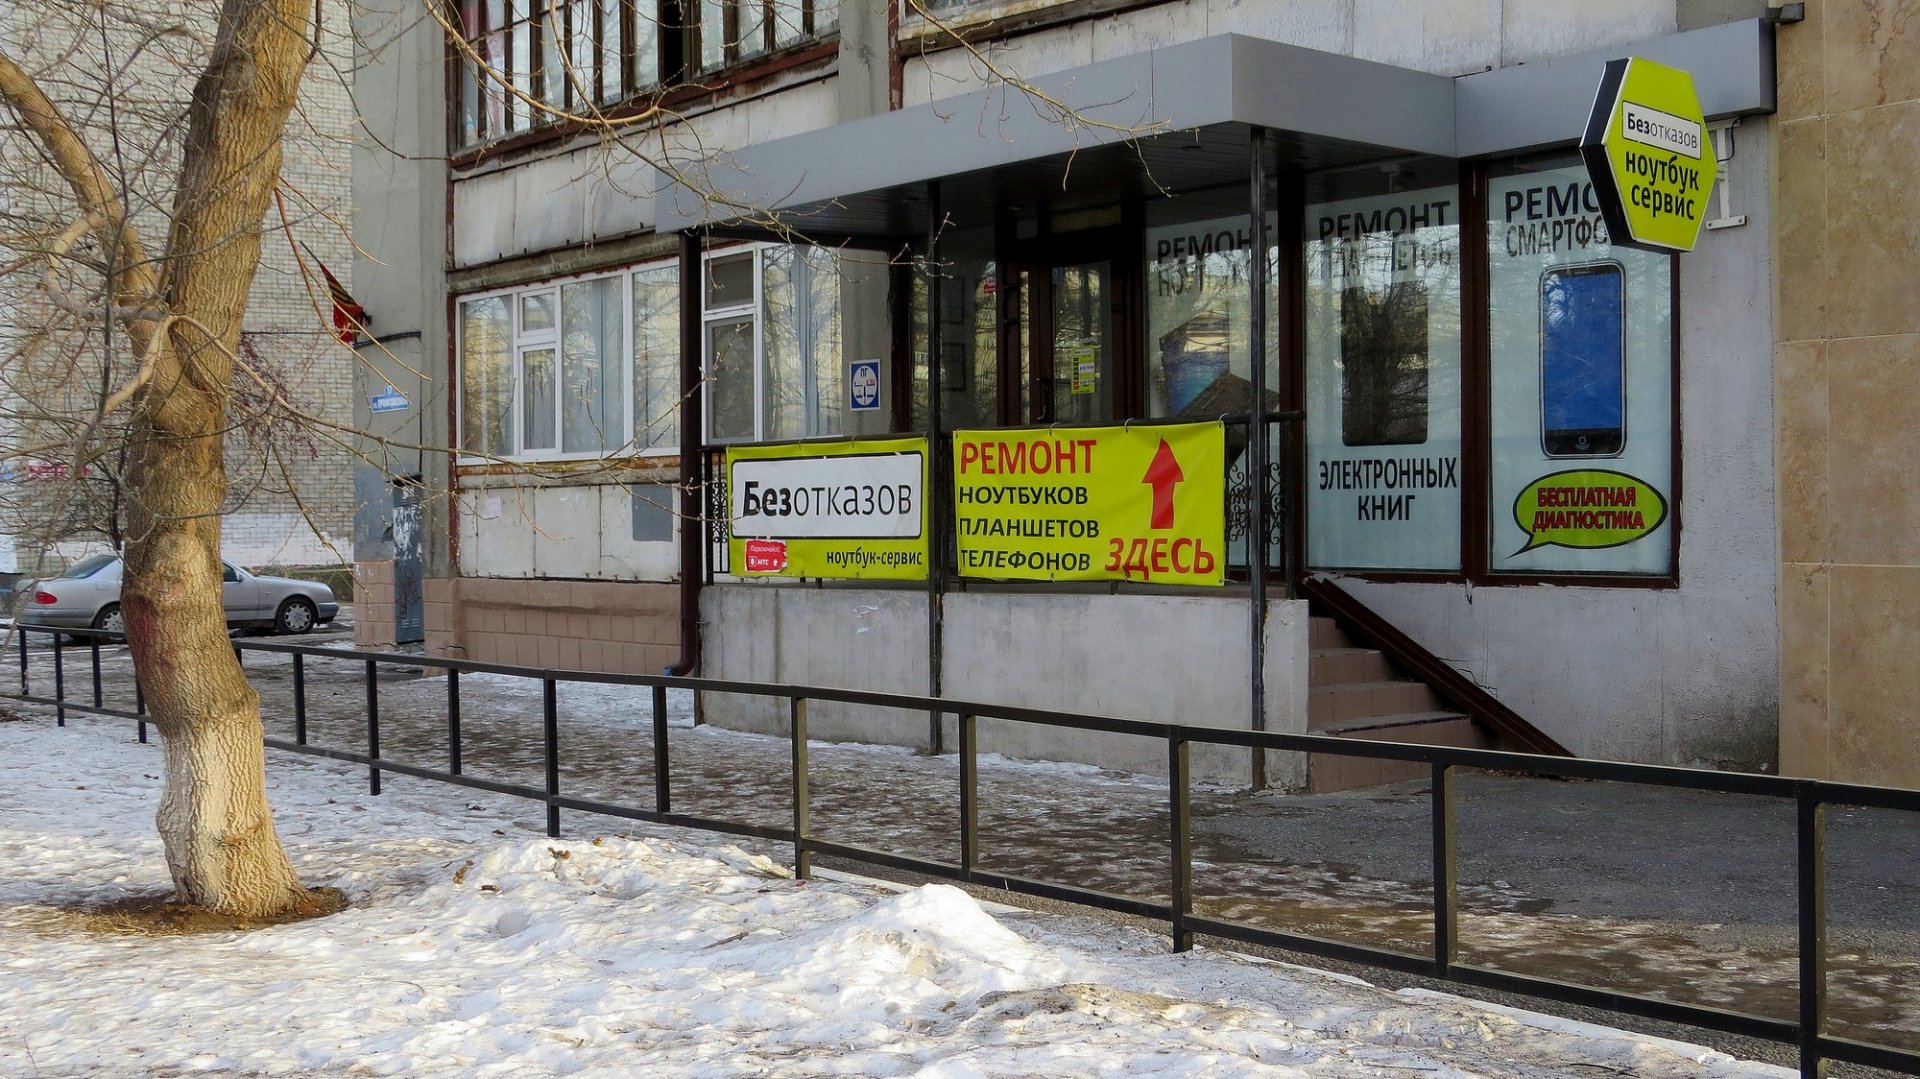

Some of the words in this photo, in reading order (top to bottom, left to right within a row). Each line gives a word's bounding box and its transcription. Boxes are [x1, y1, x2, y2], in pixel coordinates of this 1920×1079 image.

[1626, 111, 1699, 150] Безотказов
[1625, 151, 1699, 191] ноутбук
[1505, 182, 1600, 223] РЕМО
[1630, 186, 1695, 221] сервис
[1319, 201, 1450, 243] РЕМОНТ
[1506, 215, 1609, 258] СМАРТФО
[1157, 224, 1273, 264] РЕМОН
[960, 439, 1097, 475] РЕМОНТ
[1319, 457, 1457, 491] ЭЛЕКТРОННЫХ
[743, 481, 912, 517] Безотказов
[960, 486, 1088, 506] НОУТБУКОВ
[1358, 495, 1416, 521] КНИГ
[1538, 487, 1636, 508] БЕСПЛАТНАЯ
[960, 517, 1100, 538] ПЛАНШЕТОВ
[1532, 510, 1644, 533] ДИАГНОСТИКА
[826, 545, 923, 569] ноутбук-сервис
[960, 548, 1091, 571] ТЕЛЕФОНОВ
[1105, 537, 1215, 581] ЗДЕСЬ
